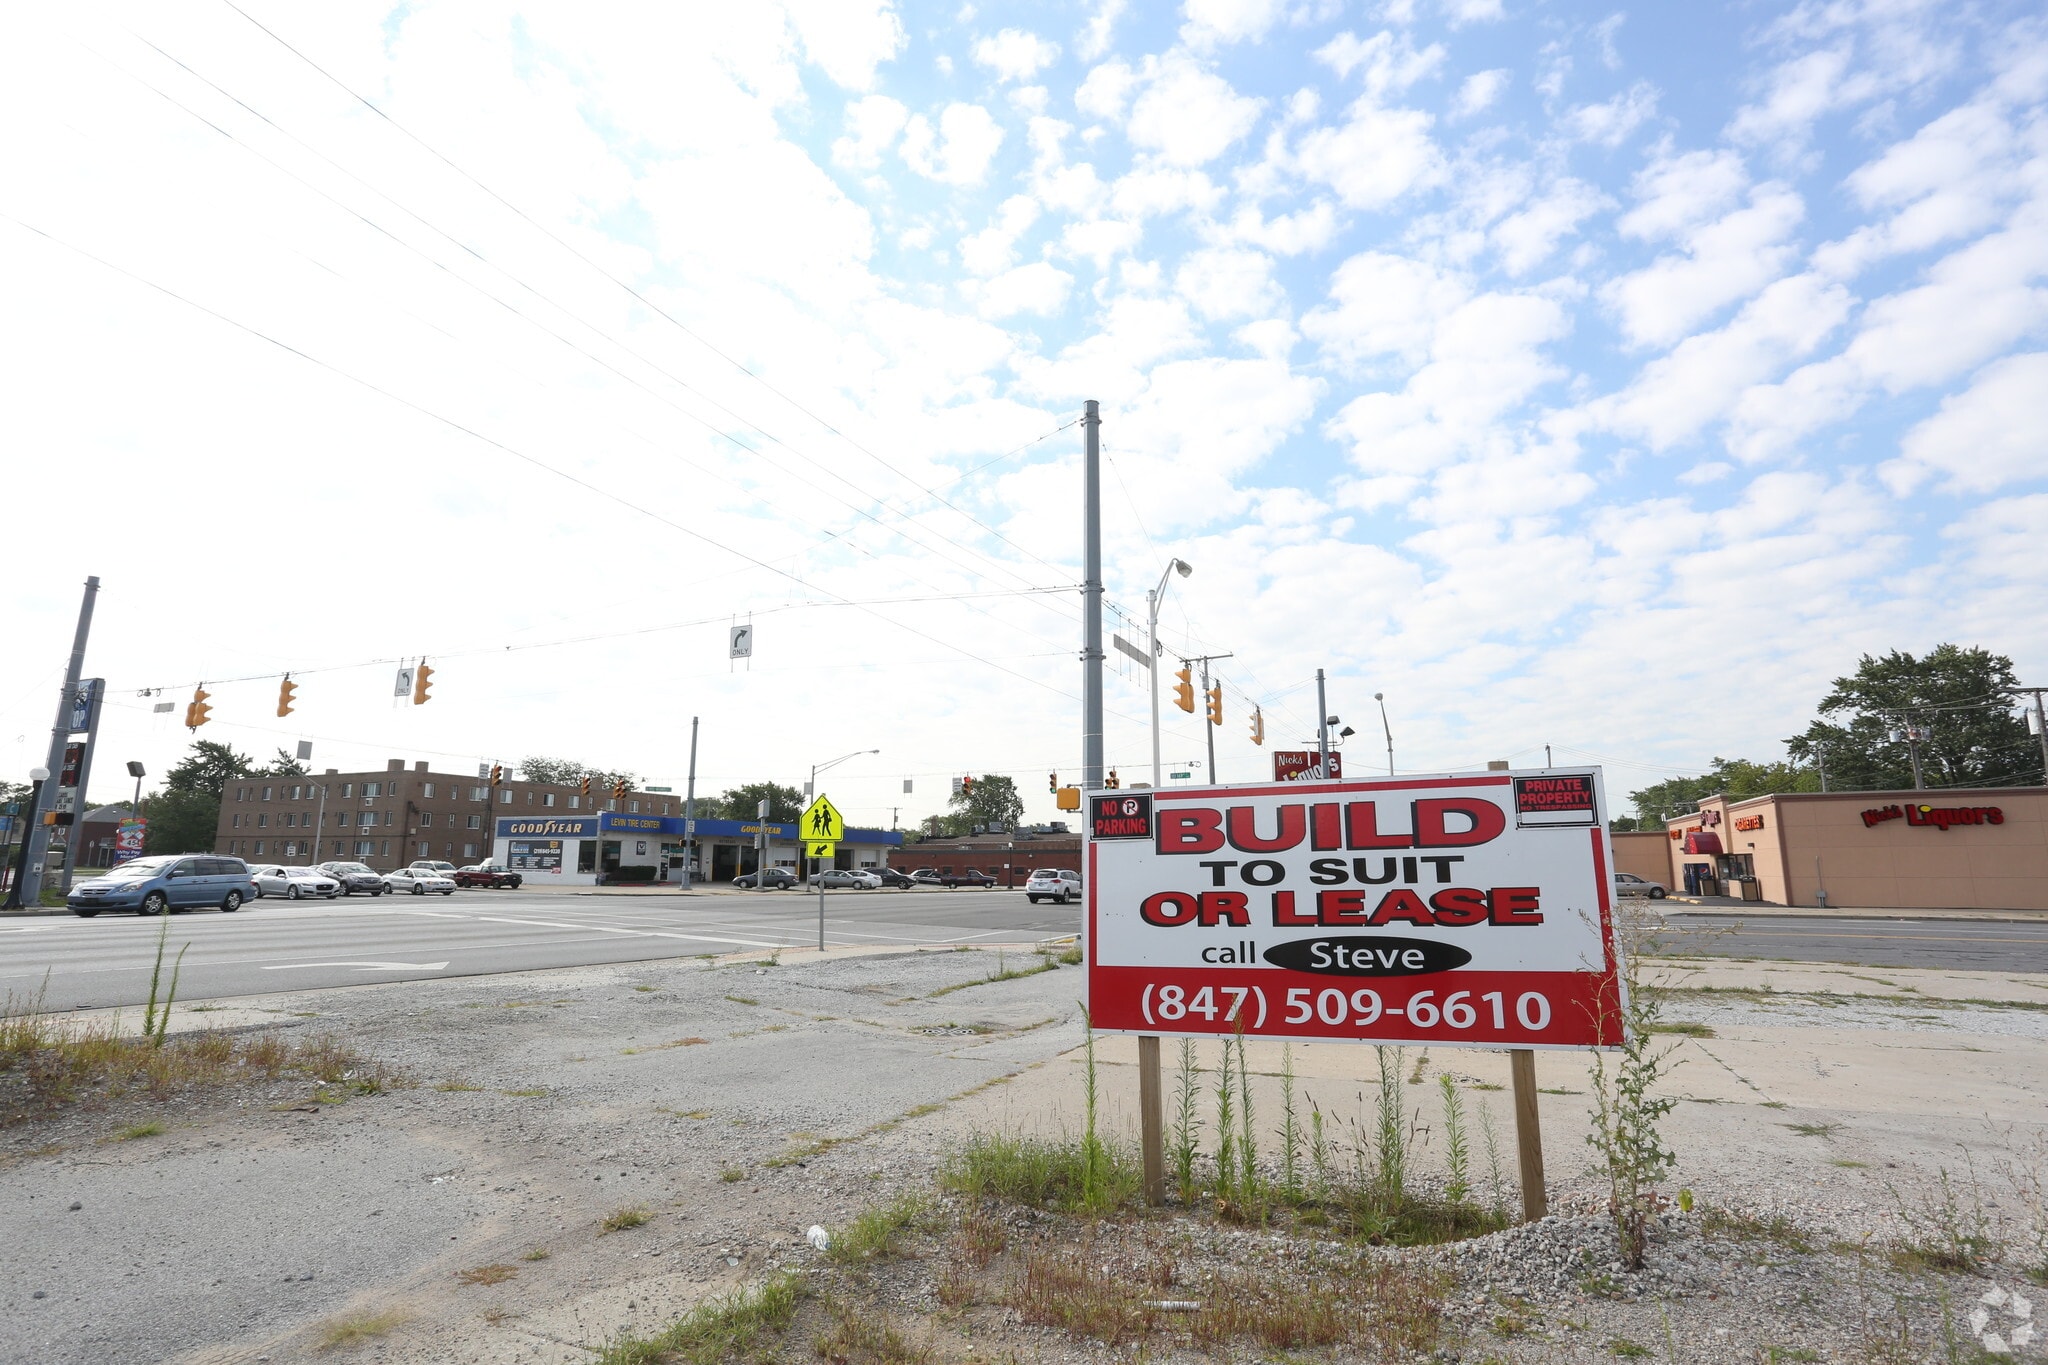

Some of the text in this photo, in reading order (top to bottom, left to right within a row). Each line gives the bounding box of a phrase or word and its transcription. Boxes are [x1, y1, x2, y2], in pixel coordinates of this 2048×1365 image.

[732, 648, 749, 656] ONLY
[1278, 754, 1303, 767] Nicks
[1525, 779, 1583, 792] PRIVATE
[1520, 791, 1591, 805] PROPERTY
[1101, 800, 1118, 816] NO
[610, 817, 661, 829] LEVIN TIRE CENTER
[1096, 817, 1147, 835] PARKING
[1156, 797, 1506, 855] BUILD
[1905, 804, 2004, 831] Liquors
[510, 820, 582, 836] GOODYEAR
[1199, 855, 1464, 887] TO SUIT
[1140, 886, 1544, 928] OR LEASE
[1202, 941, 1425, 970] call Steve
[1141, 983, 1551, 1031] (847) 509-6610
